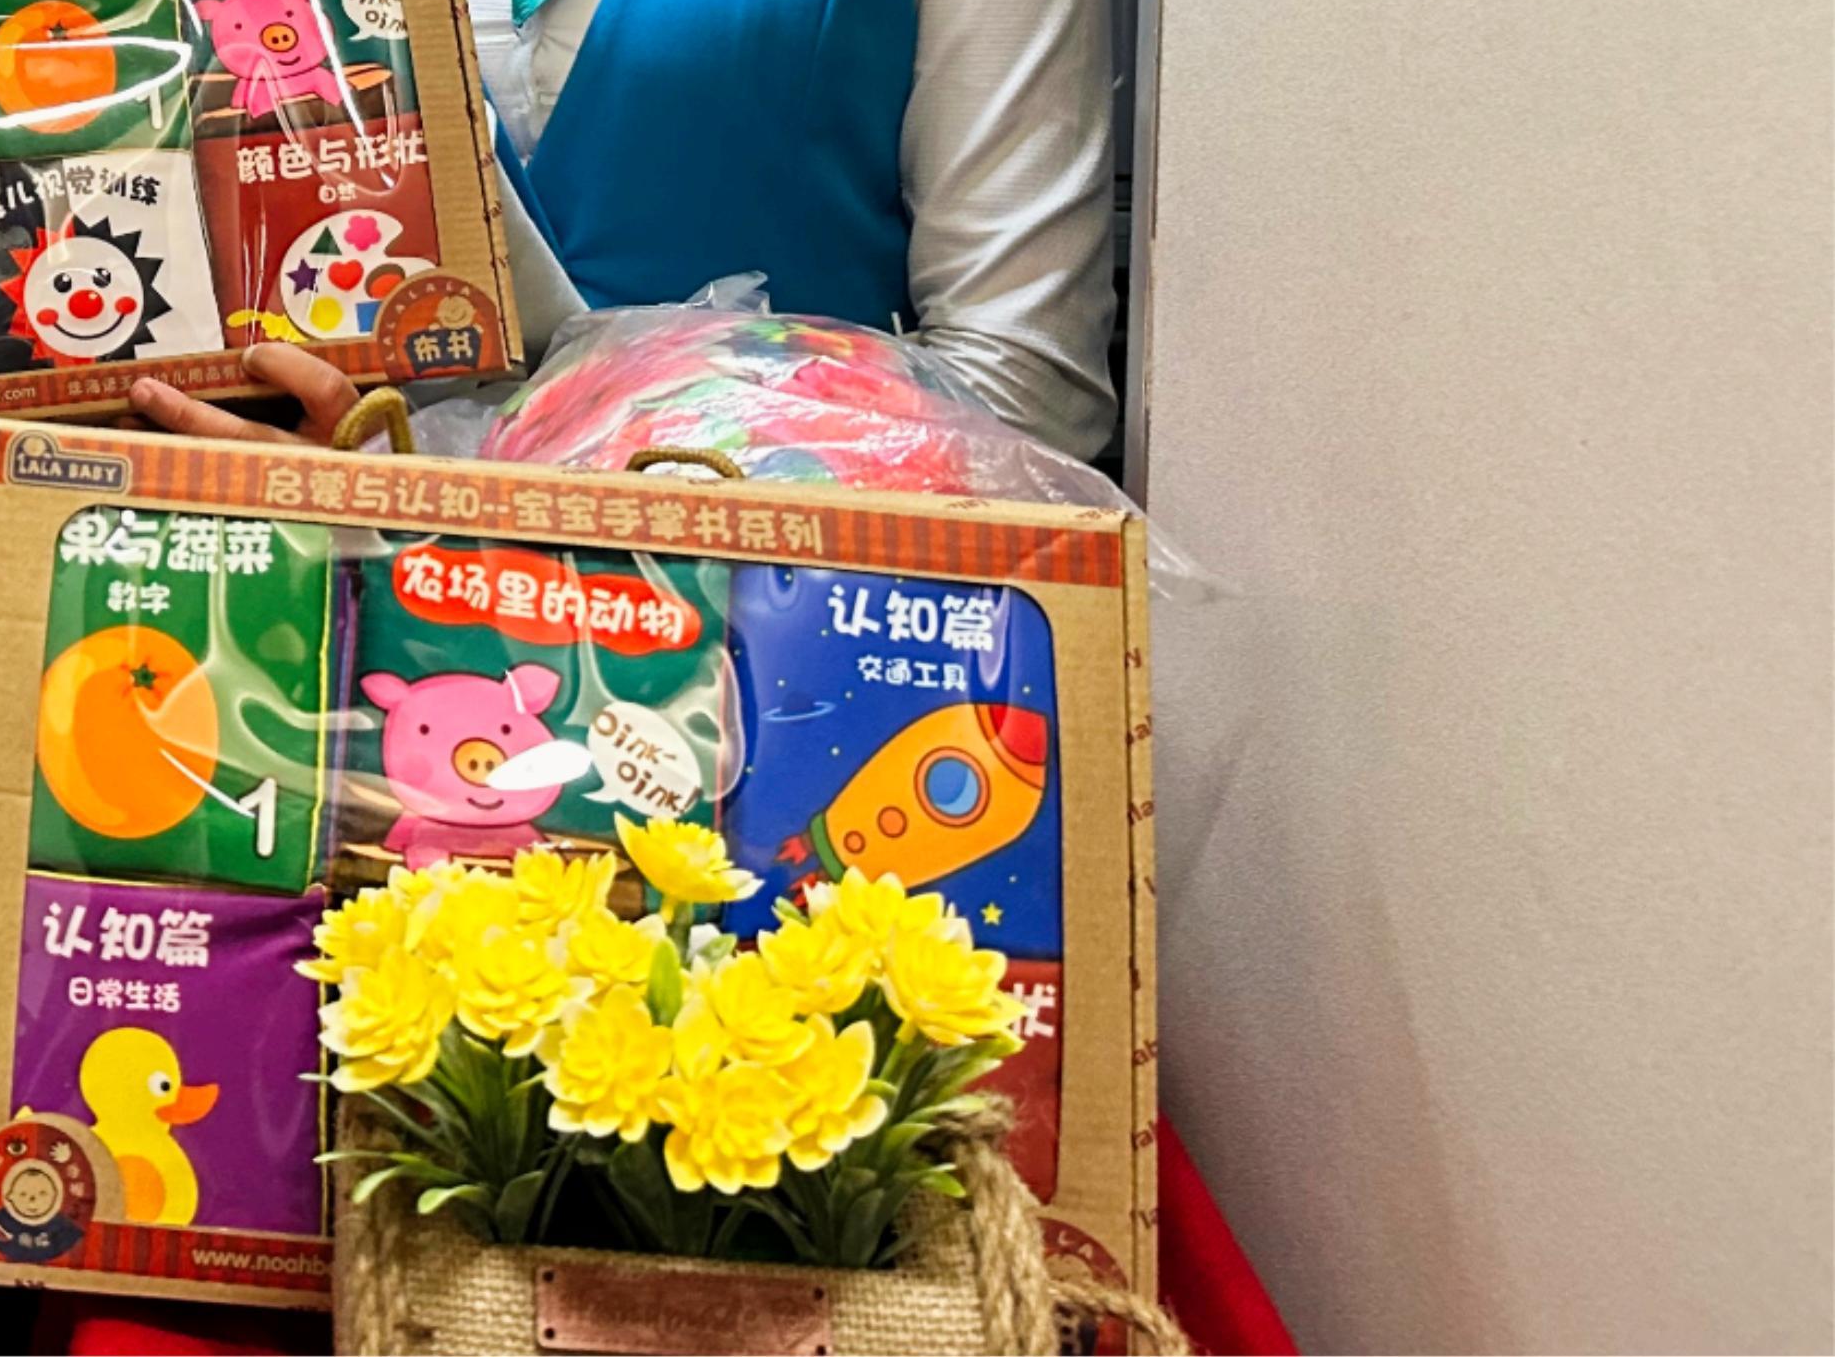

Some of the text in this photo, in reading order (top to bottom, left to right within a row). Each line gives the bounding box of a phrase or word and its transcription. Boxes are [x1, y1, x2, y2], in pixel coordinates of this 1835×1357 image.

[236, 131, 428, 184] 颜色与形状
[414, 330, 474, 363] 布书
[16, 453, 117, 483] LALA BABY
[107, 581, 171, 615] 数字
[400, 553, 686, 644] 农场里的动物
[827, 584, 995, 652] 认知篇
[857, 654, 968, 692] 交通工具
[237, 776, 278, 857] 1
[42, 901, 213, 968] 认知篇
[67, 976, 182, 1014] 日常生活
